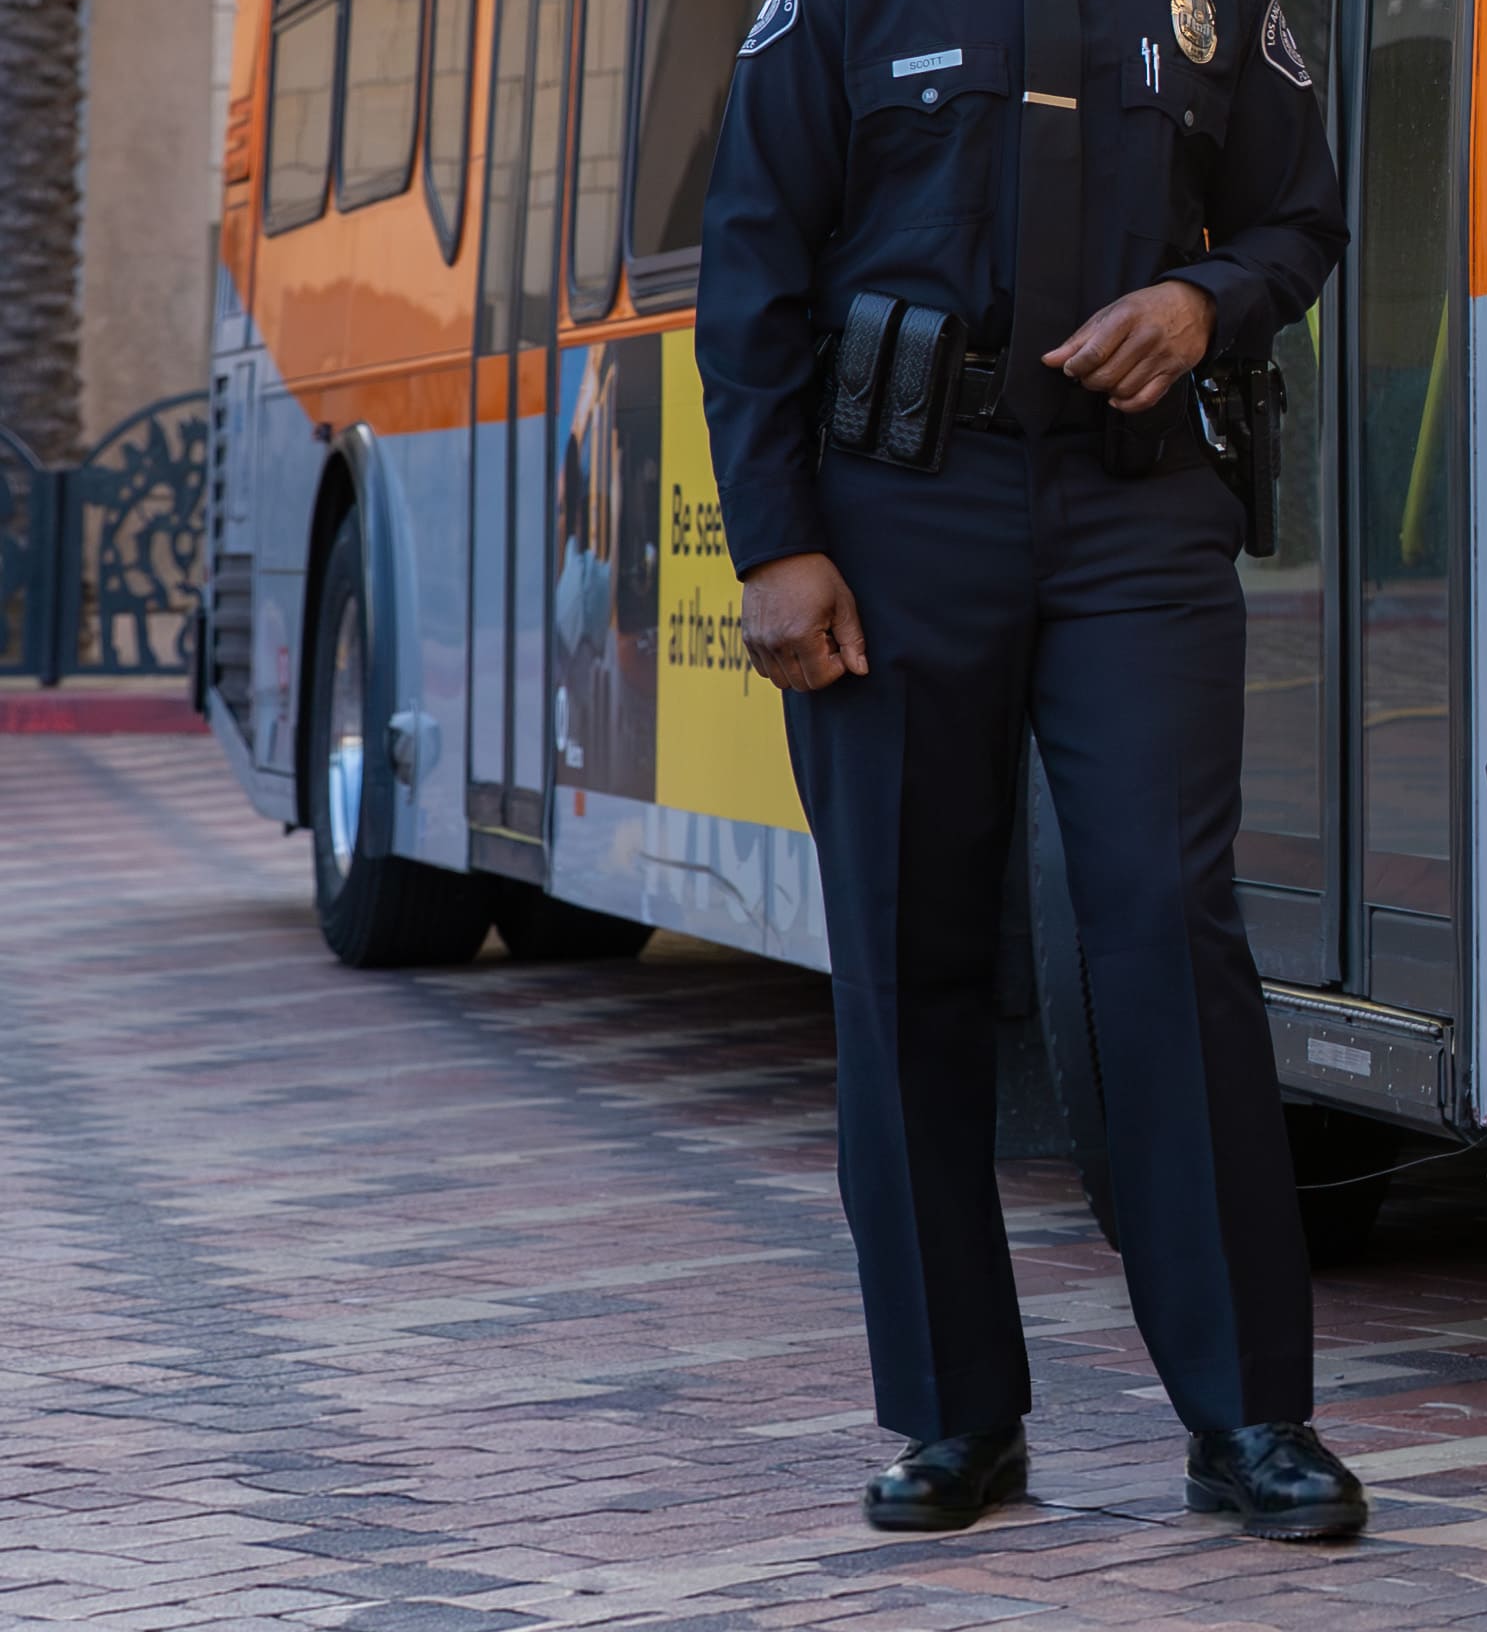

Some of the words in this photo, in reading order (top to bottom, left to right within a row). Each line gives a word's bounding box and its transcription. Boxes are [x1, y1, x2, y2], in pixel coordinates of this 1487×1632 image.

[909, 56, 943, 70] SCOTT
[671, 484, 690, 556] Be
[669, 600, 683, 666] at
[689, 586, 714, 669] the
